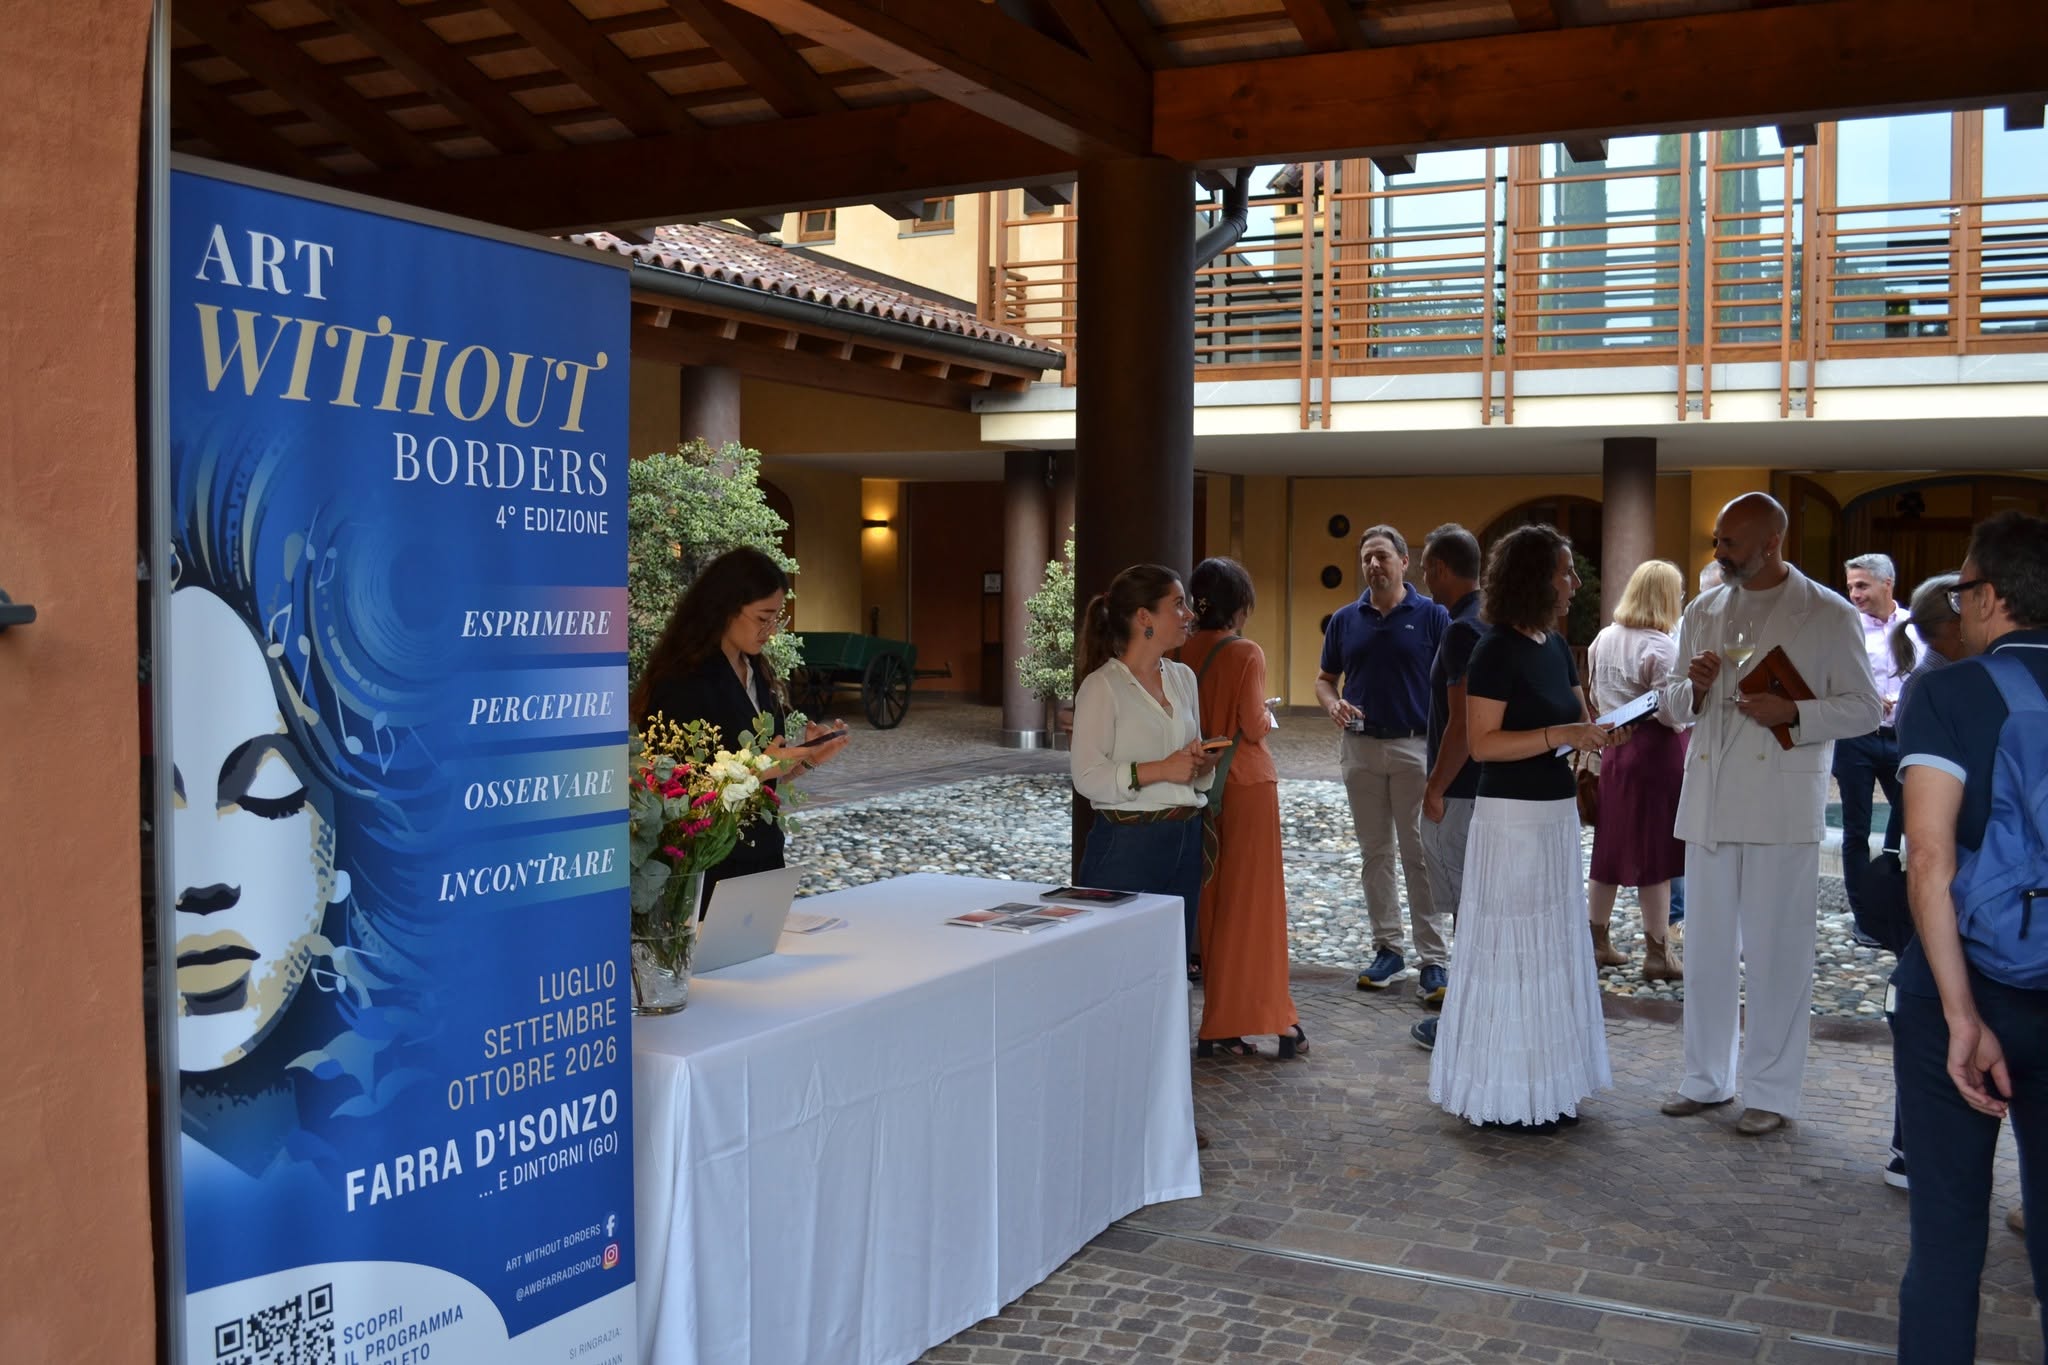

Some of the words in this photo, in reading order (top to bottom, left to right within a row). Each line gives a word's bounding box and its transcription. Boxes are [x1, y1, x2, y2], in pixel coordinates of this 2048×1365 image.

[195, 224, 334, 300] ART
[194, 303, 608, 432] WITHOUT
[393, 432, 608, 496] BORDERS
[525, 507, 608, 535] EDIZIONE
[461, 611, 611, 637] ESPRIMERE
[469, 692, 614, 725] PERCEPIRE
[464, 769, 614, 811] OSSERVARE
[438, 848, 615, 902] INCONTRARE
[539, 960, 616, 1004] LUGLIO
[484, 998, 617, 1059] SETTEMBRE
[448, 1052, 556, 1111] OTTOBRE
[565, 1036, 617, 1075] 2026
[346, 1139, 463, 1213] FARRA
[475, 1088, 618, 1169] D'ISONZO
[499, 1170, 508, 1191] E
[513, 1147, 583, 1186] DINTORNI
[588, 1131, 618, 1164] (GO)
[506, 1256, 522, 1271] ART
[525, 1240, 561, 1264] WITHOUT
[563, 1224, 601, 1248] BORDERS
[516, 1255, 601, 1301] @AWBFARRADISONZO
[343, 1305, 402, 1344] SCOPRI
[345, 1351, 359, 1365] IL
[365, 1305, 463, 1362] PROGRAMMA
